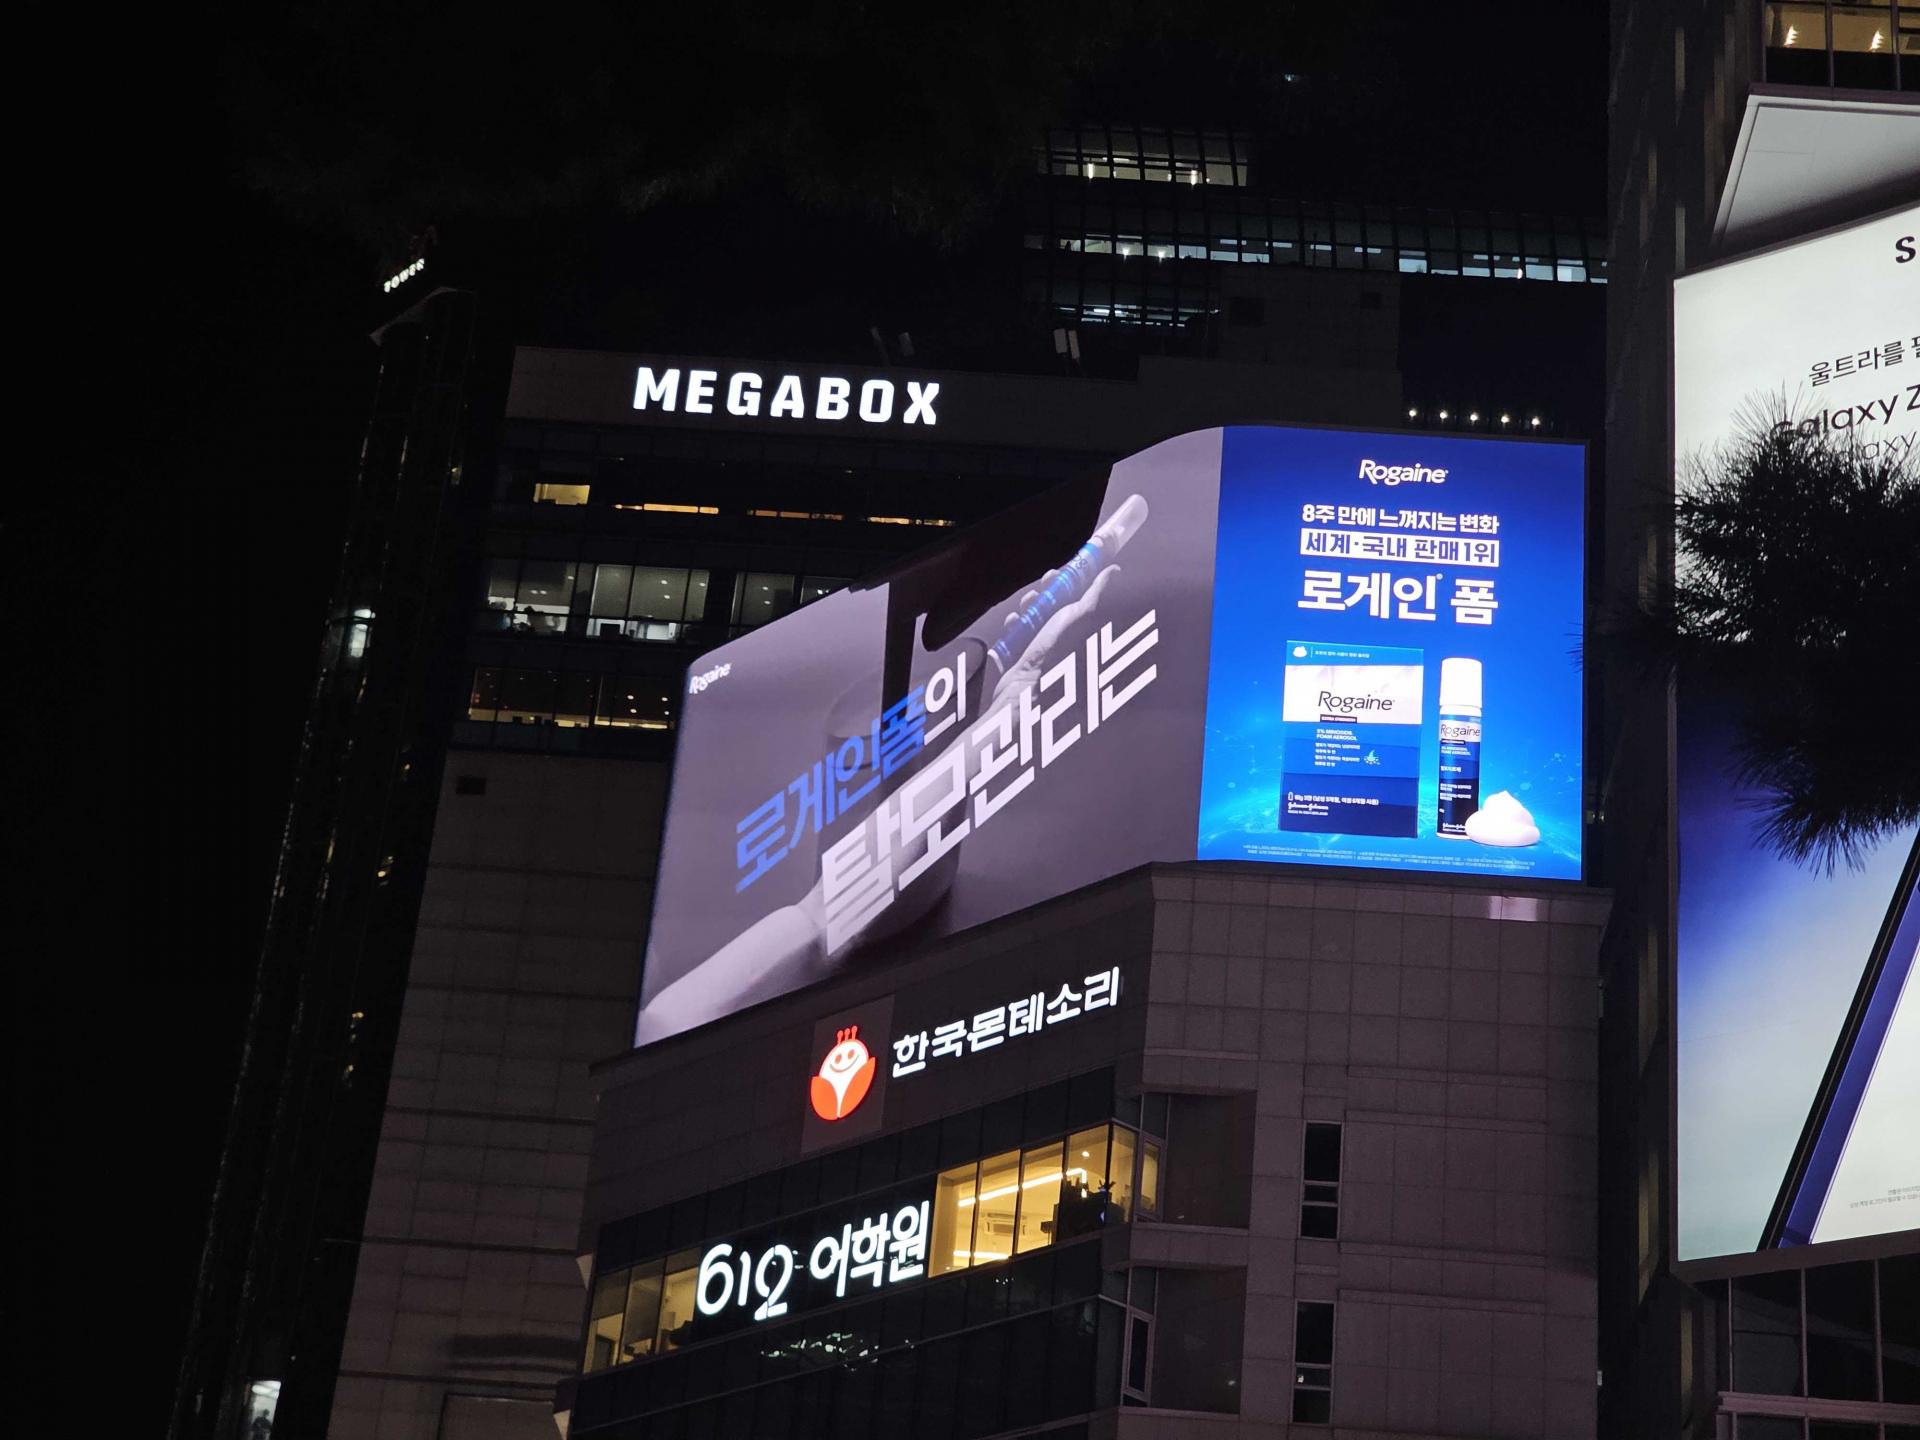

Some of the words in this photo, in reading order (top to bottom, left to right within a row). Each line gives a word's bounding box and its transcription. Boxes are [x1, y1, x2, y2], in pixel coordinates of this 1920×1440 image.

[1809, 340, 1905, 388] 울트라를
[633, 366, 940, 425] MEGABOX
[1358, 459, 1448, 486] Rogaine
[1302, 504, 1335, 525] 8주
[1337, 506, 1376, 528] 만에
[1378, 509, 1457, 533] 느껴지는
[1459, 513, 1500, 535] 변화
[1450, 578, 1499, 626] 폼
[688, 662, 733, 694] Rogaine
[1318, 690, 1393, 713] Rogaine
[1440, 723, 1481, 738] Rogaine
[821, 608, 1159, 956] 탈모관리는
[891, 965, 1121, 1079] 한국몬테소리
[809, 1199, 930, 1298] 어학원
